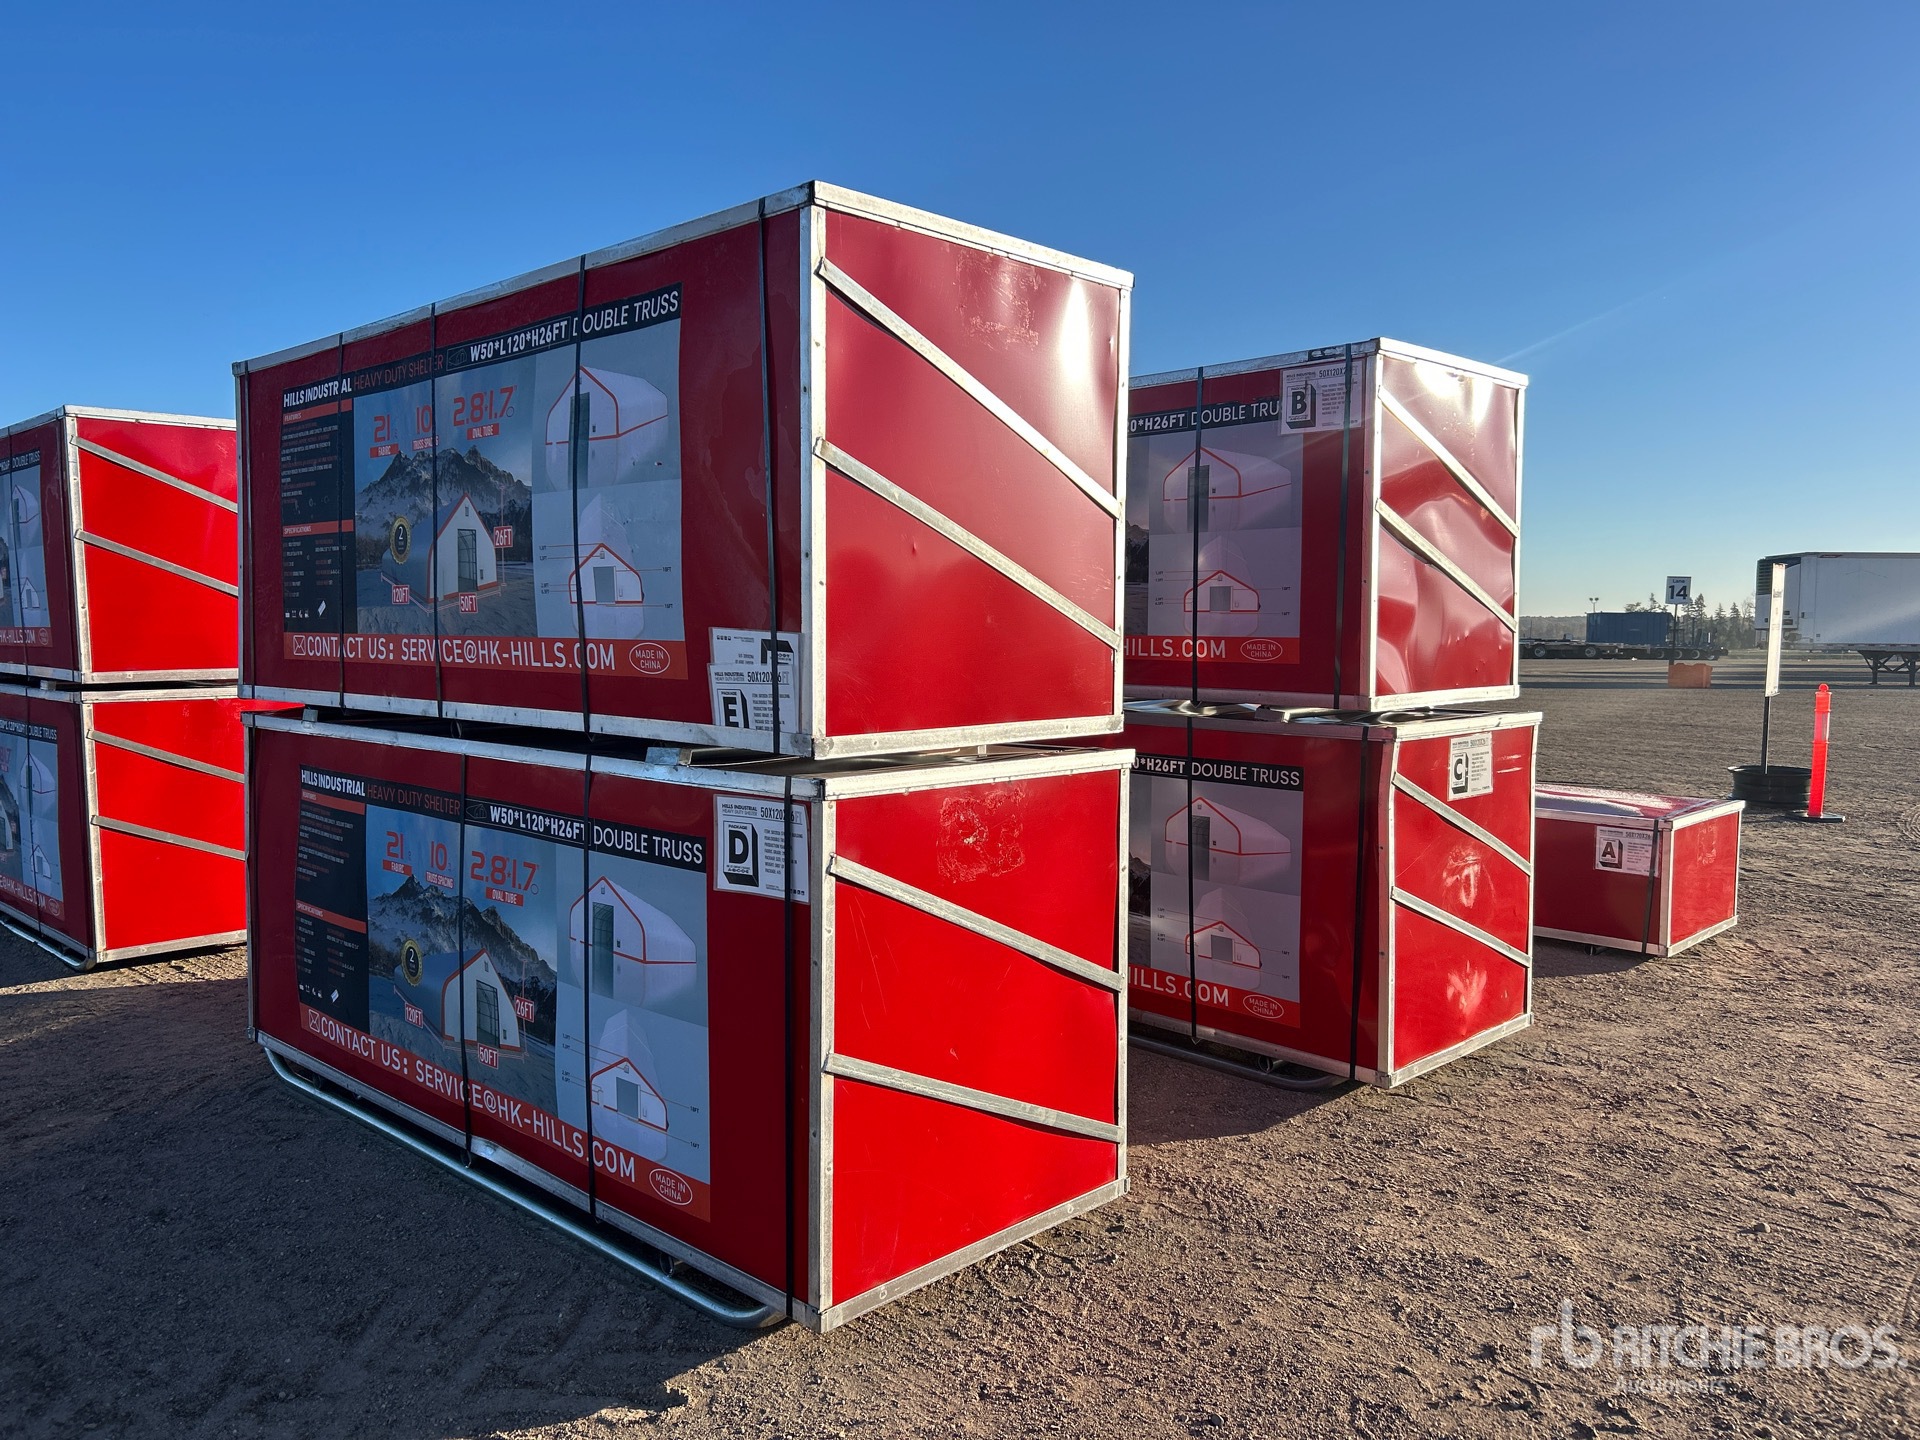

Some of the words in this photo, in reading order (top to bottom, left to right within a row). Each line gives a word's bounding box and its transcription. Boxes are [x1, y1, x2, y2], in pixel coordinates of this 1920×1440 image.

[634, 290, 679, 323] TRUSS
[284, 390, 304, 408] HILLS
[305, 378, 352, 403] INDUSTRAL
[354, 372, 383, 391] HEAVY
[385, 367, 407, 384] DUTY
[1292, 391, 1307, 416] B
[374, 414, 391, 443] 21
[417, 405, 433, 435] 10
[495, 528, 513, 546] 26FT
[393, 588, 409, 603] 120FT
[461, 596, 477, 611] 50FT
[1669, 585, 1688, 600] 14
[308, 636, 364, 659] CONTACT
[368, 638, 394, 660] US:
[636, 650, 655, 659] MADE
[656, 650, 664, 659] IN
[641, 660, 662, 670] CHINA
[723, 697, 740, 728] E
[1191, 762, 1247, 781] DOUBLE
[1252, 768, 1300, 786] TRUSS
[1454, 758, 1463, 781] C
[302, 770, 318, 787] HILLS
[319, 777, 366, 797] INDUSTRIAL
[368, 784, 395, 802] HEAVY
[398, 790, 422, 807] DUTY
[424, 794, 461, 816] SHELTER
[386, 831, 404, 860] 21
[430, 841, 448, 871] 10
[594, 826, 648, 854] DOUBLE
[653, 836, 703, 865] TRUSS
[729, 830, 749, 864] D
[1602, 842, 1617, 859] A
[516, 998, 533, 1021] 26FT
[1249, 998, 1269, 1009] MADE
[1253, 1005, 1274, 1017] CHINA
[406, 1007, 422, 1026] 120FT
[321, 1017, 376, 1060] CONTACT
[381, 1044, 408, 1075] US:
[479, 1047, 498, 1068] 50FT
[655, 1174, 676, 1191] MADE
[677, 1184, 686, 1194] IN
[660, 1185, 682, 1202] CHINA
